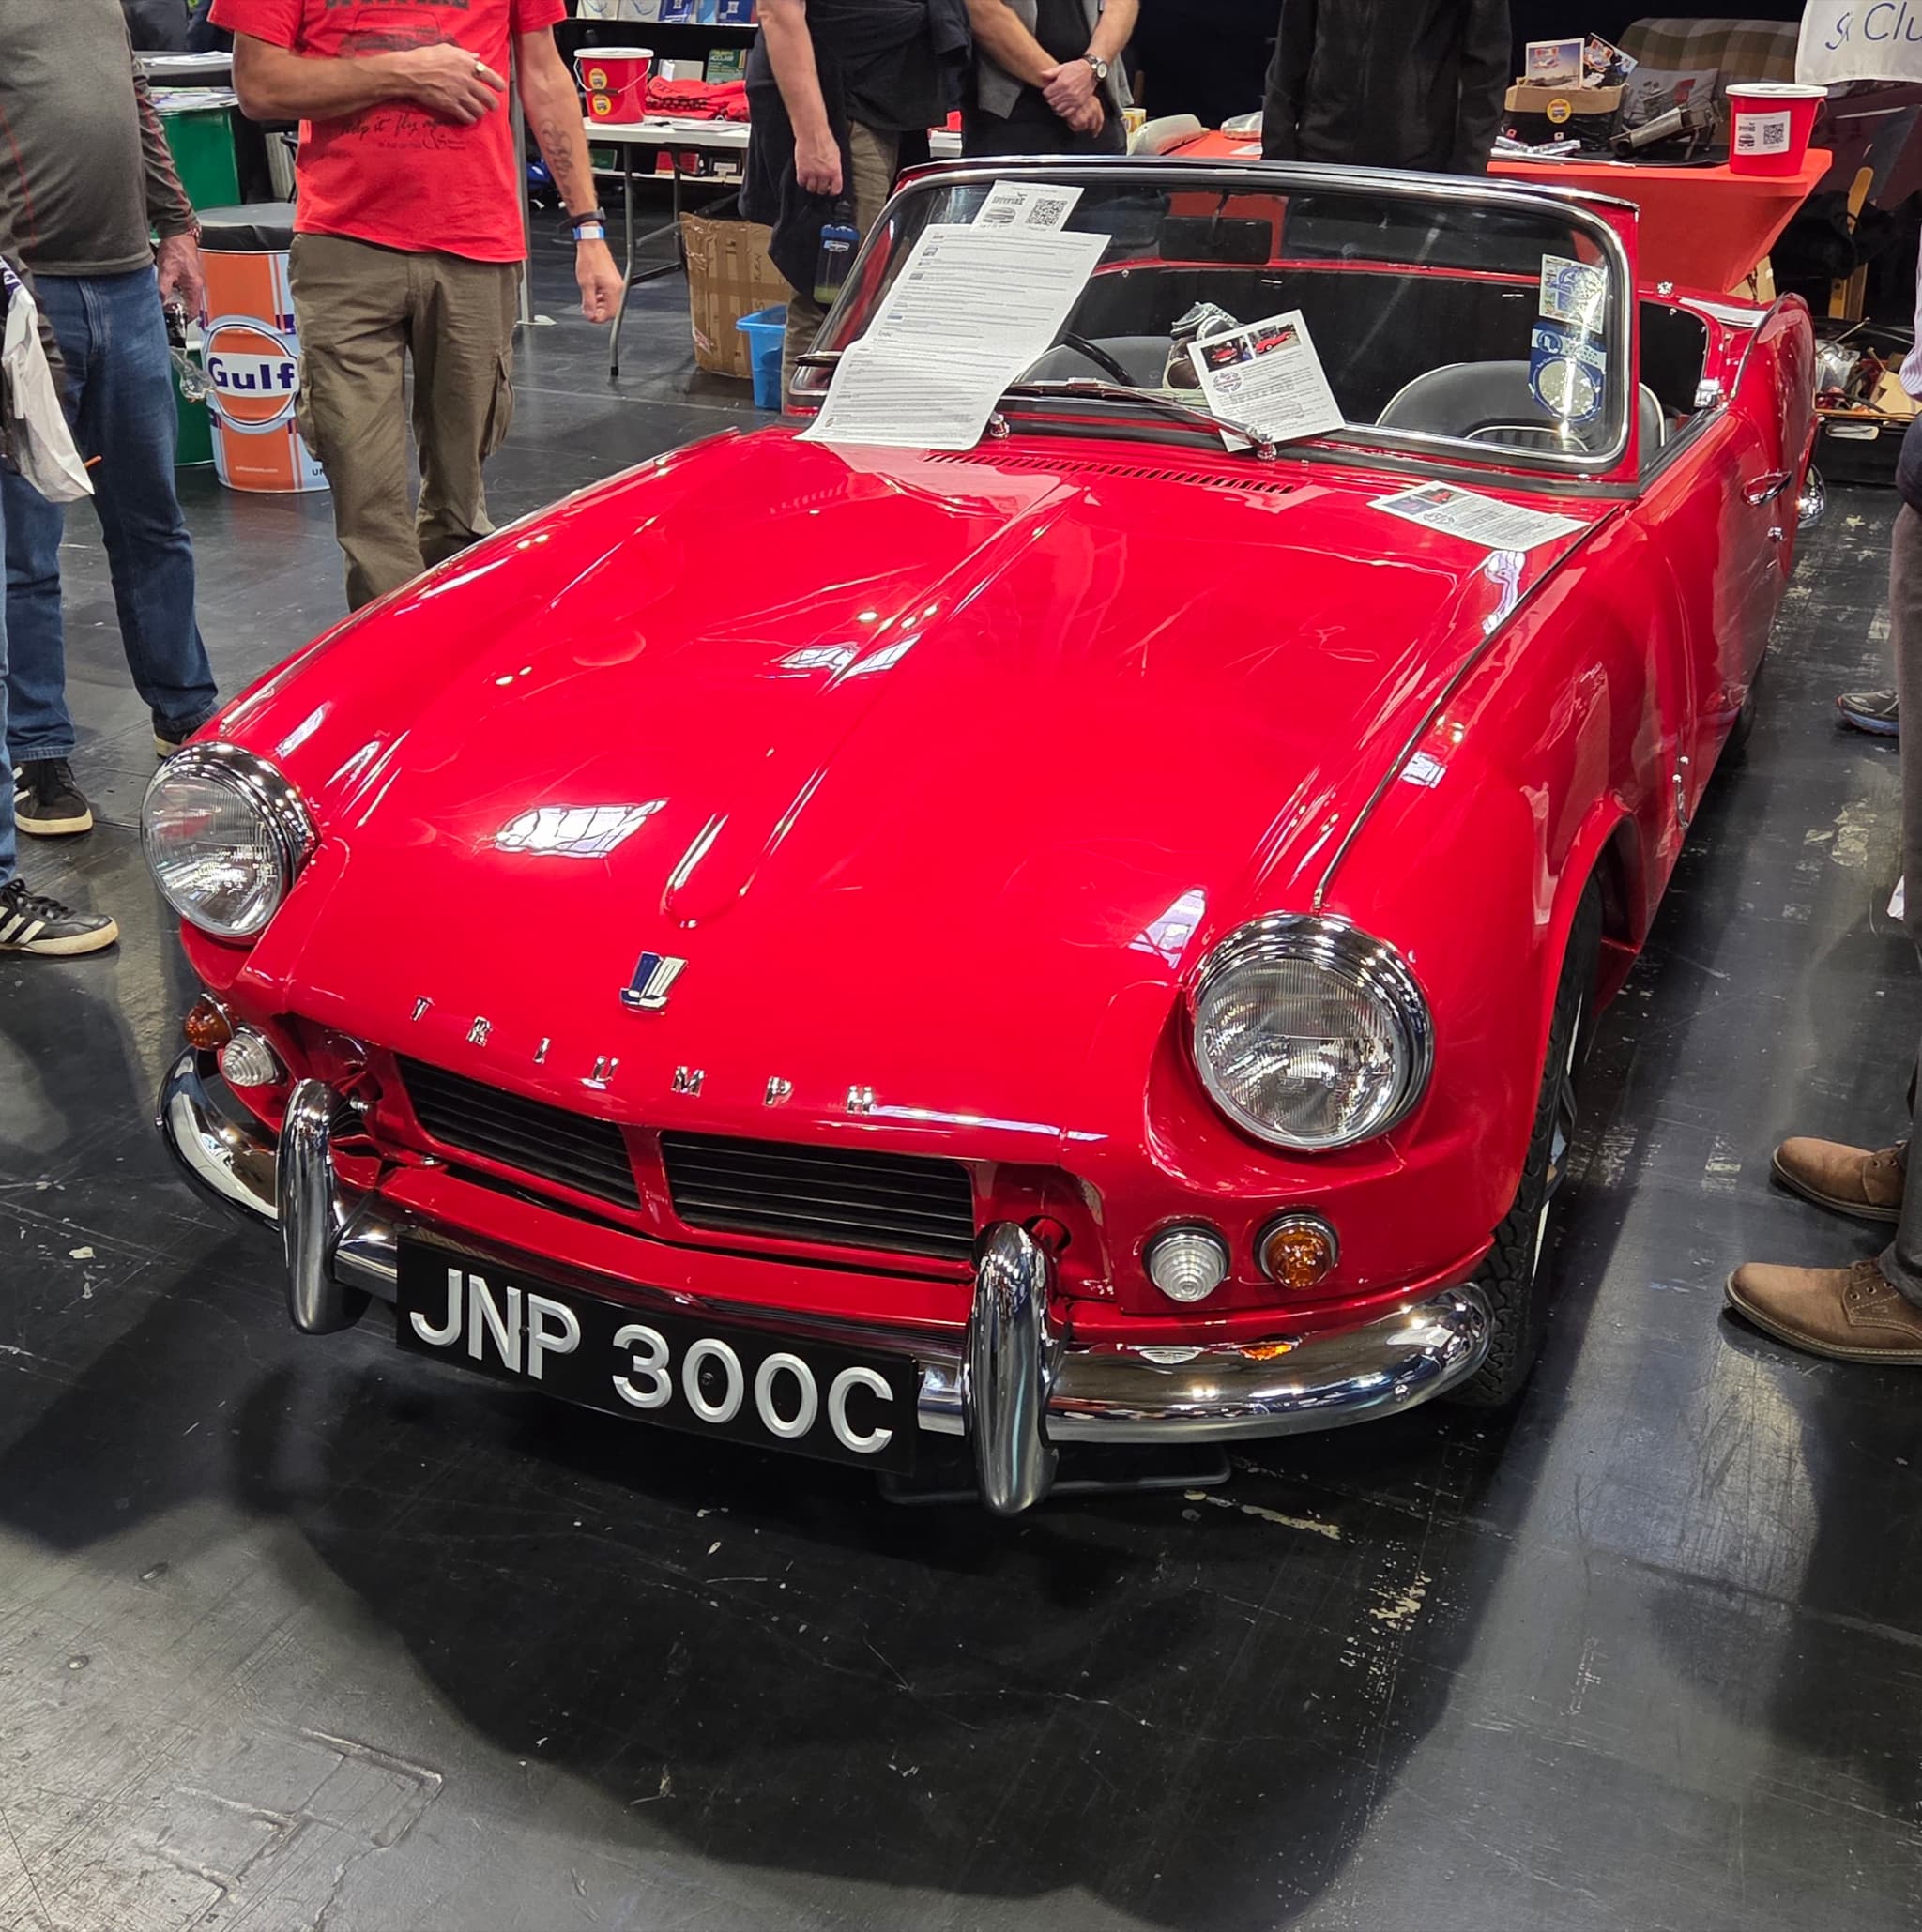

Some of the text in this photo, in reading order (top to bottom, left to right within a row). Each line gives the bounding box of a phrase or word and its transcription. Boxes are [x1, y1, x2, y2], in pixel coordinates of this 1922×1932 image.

[208, 357, 295, 390] Gulf
[410, 995, 876, 1116] TRIUMPH
[410, 1268, 894, 1453] JNP 300C
